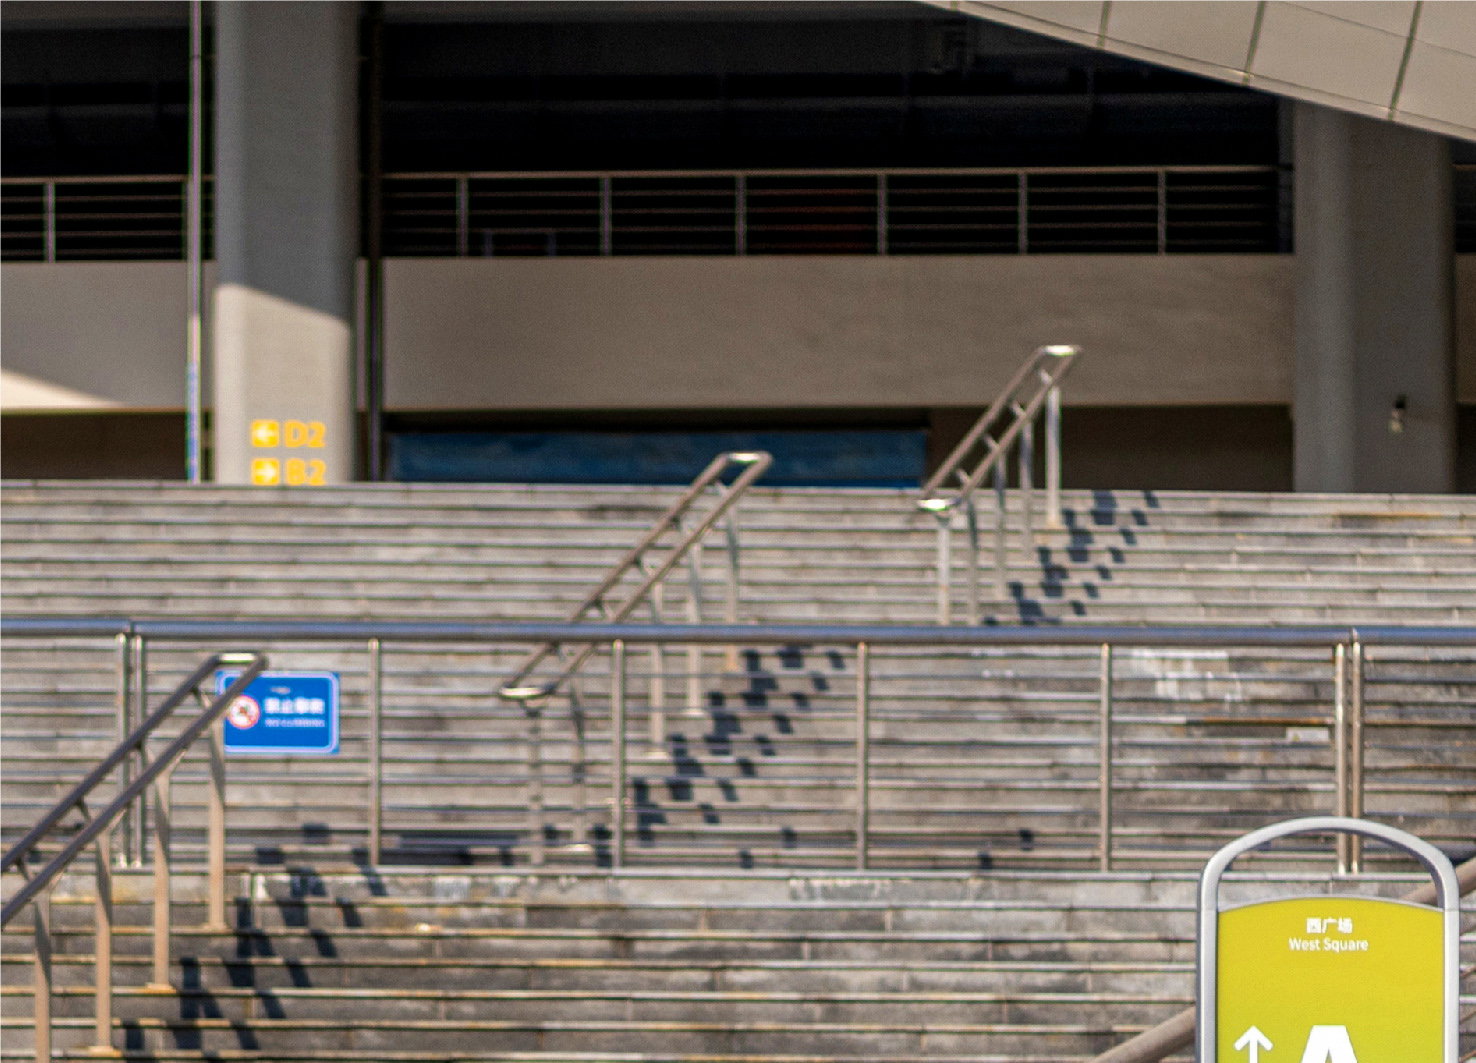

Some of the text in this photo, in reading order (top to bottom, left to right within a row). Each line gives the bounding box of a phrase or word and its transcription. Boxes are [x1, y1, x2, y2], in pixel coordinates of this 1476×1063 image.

[284, 419, 326, 448] D2
[285, 457, 327, 486] B2
[1306, 917, 1353, 934] 西广场
[1288, 937, 1369, 953] West Square
